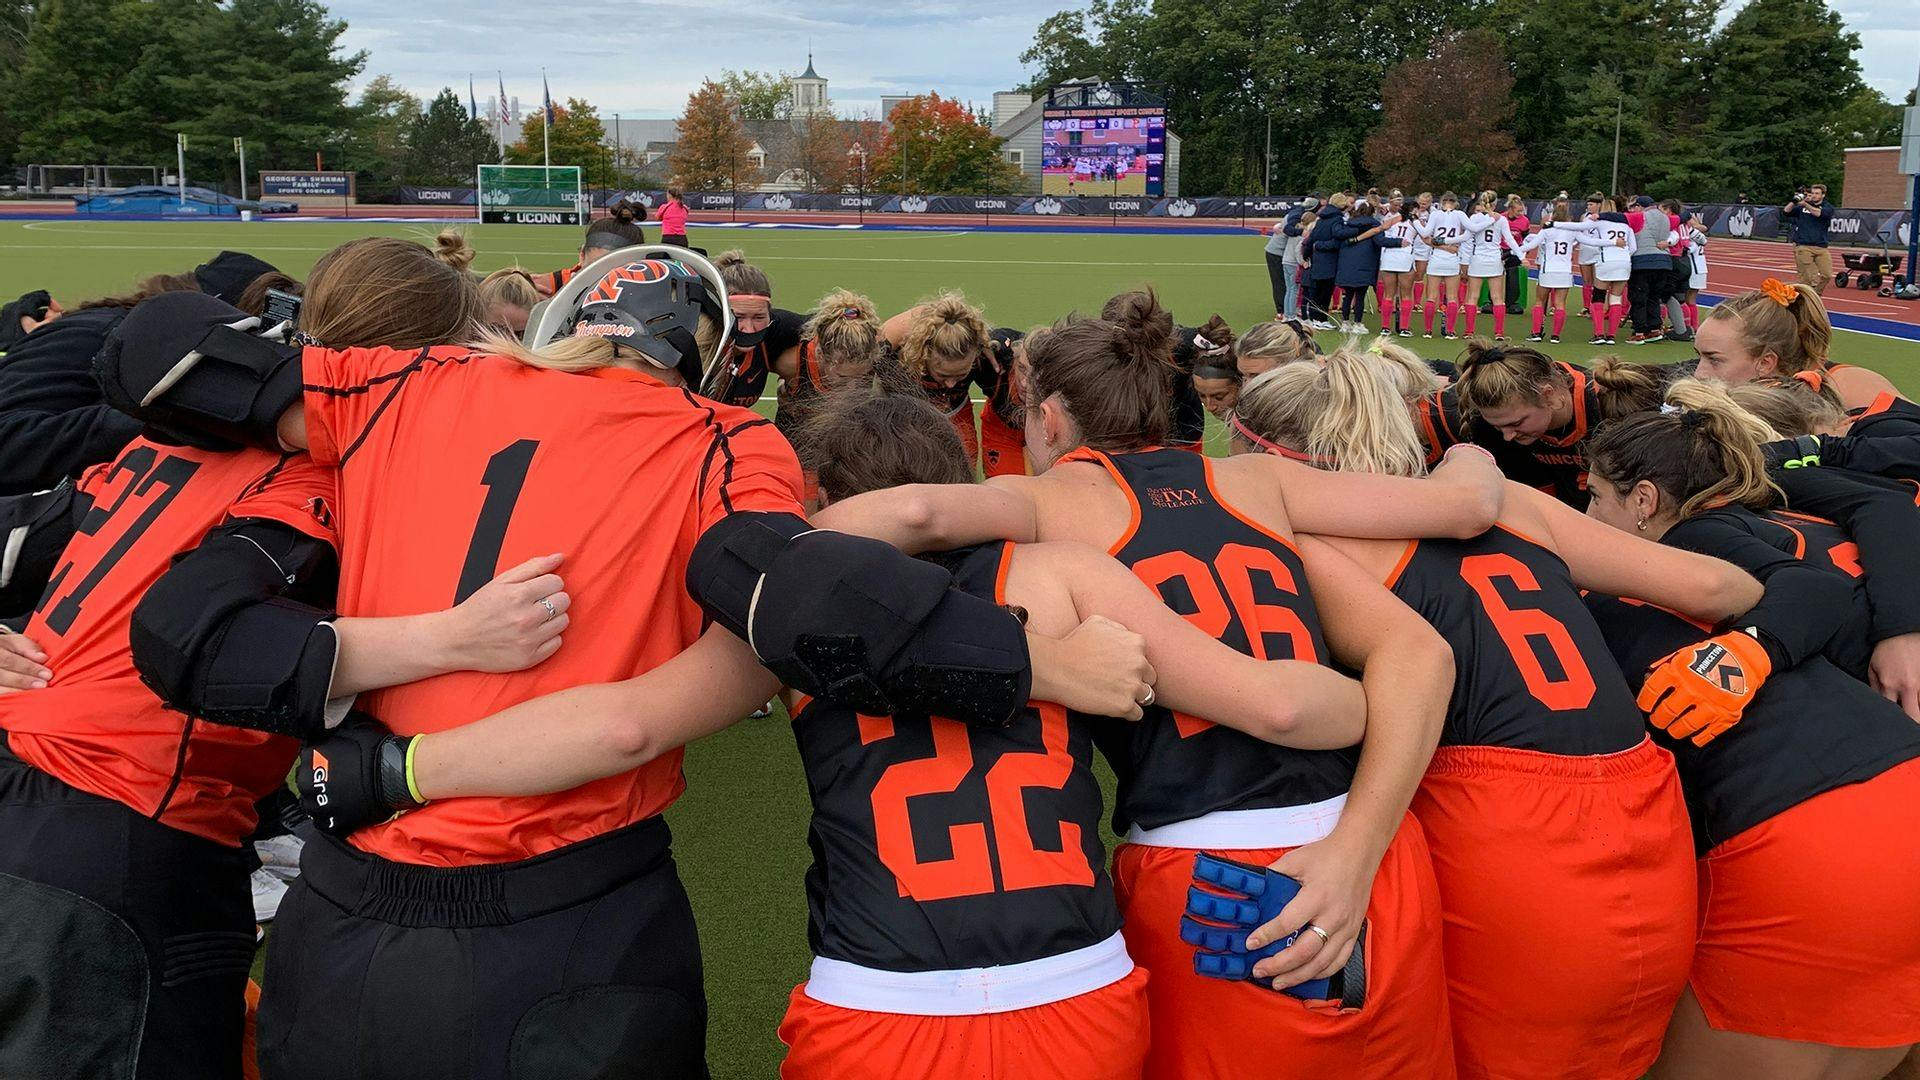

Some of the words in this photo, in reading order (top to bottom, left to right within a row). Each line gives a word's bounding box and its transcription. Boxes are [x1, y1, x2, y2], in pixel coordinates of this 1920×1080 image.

[418, 191, 451, 200] UCONN
[702, 195, 734, 204] UCONN
[841, 198, 872, 206] UCONN
[975, 200, 1006, 209] UCONN
[1109, 201, 1140, 210] UCONN
[516, 213, 561, 224] UCONN
[1397, 225, 1408, 237] 11
[1828, 218, 1860, 233] CONN
[1437, 227, 1456, 238] 24
[1484, 230, 1494, 242] 6
[1554, 241, 1568, 255] 13
[576, 320, 635, 338] Thompson
[1162, 489, 1199, 503] IVY
[453, 438, 541, 608] 1
[1459, 553, 1597, 711] 6
[1695, 645, 1724, 674] PRINCETON
[313, 767, 330, 808] Gra
[856, 700, 1096, 902] 22
